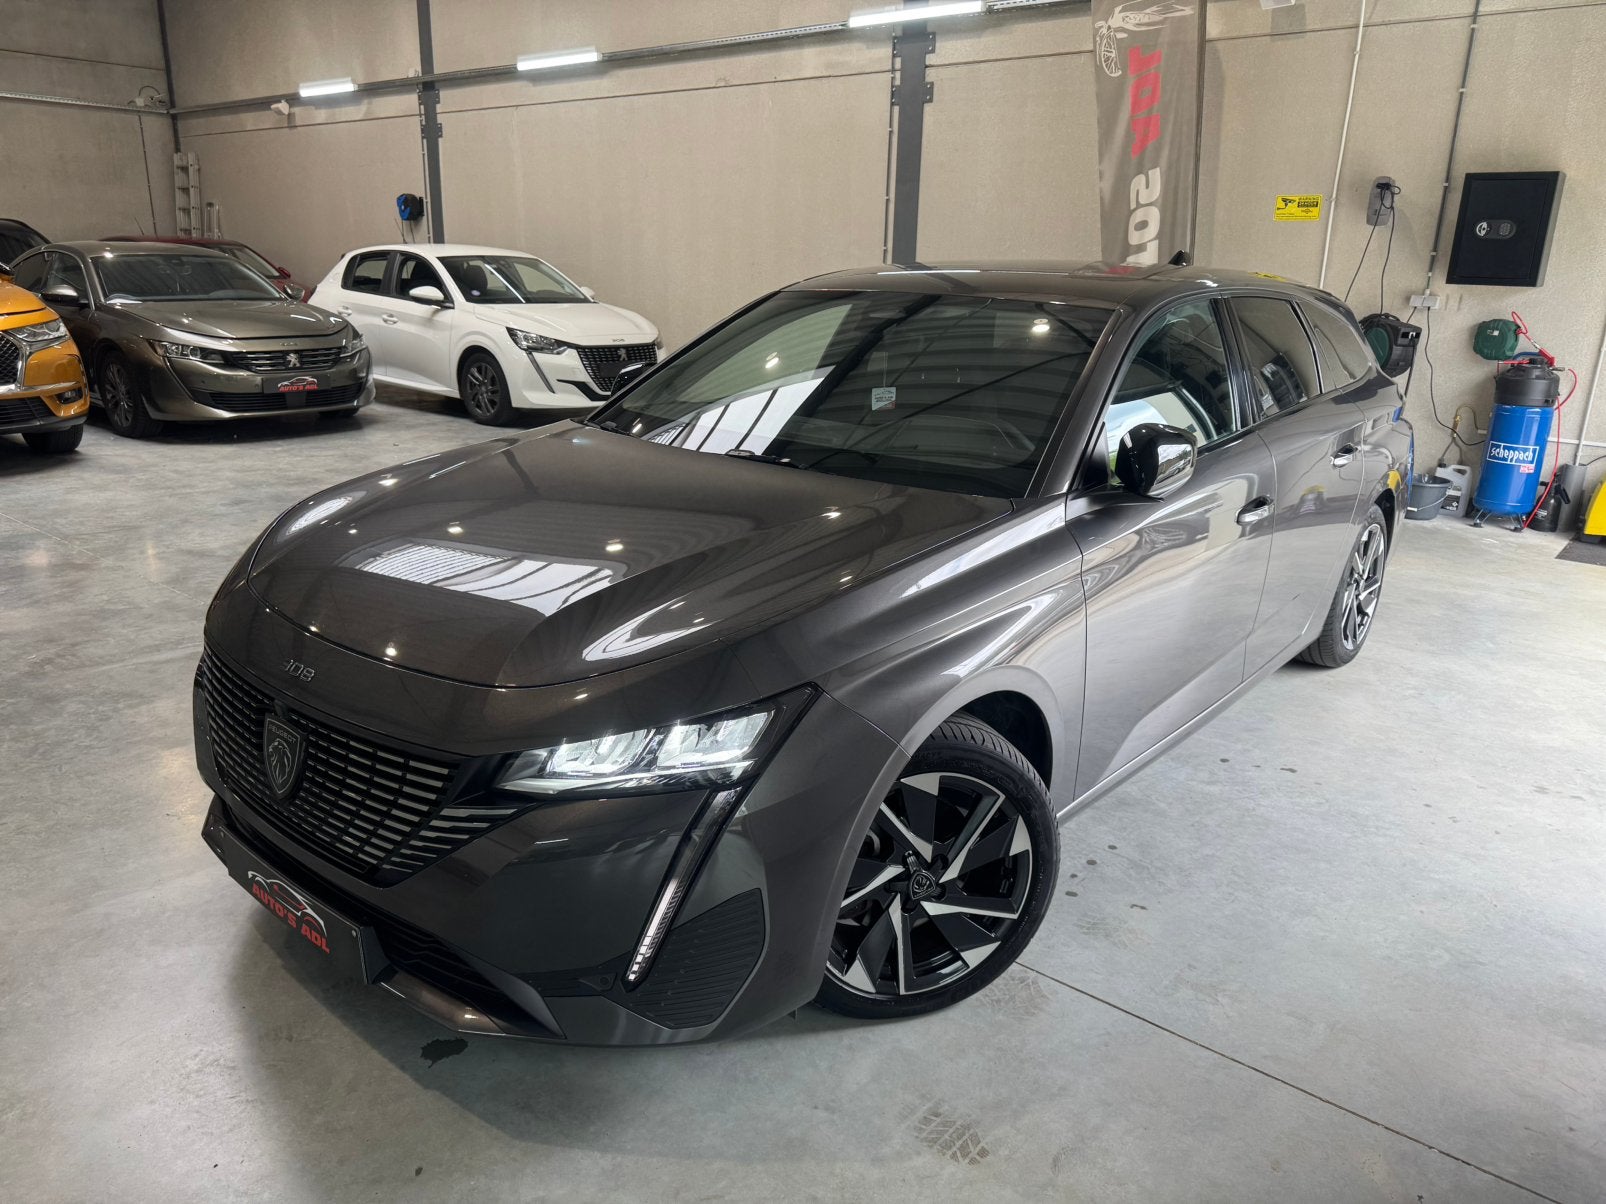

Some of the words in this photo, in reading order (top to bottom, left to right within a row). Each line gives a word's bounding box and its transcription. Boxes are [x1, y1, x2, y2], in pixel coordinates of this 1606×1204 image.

[1490, 444, 1534, 464] scheppach
[252, 882, 297, 929] AUTO'S
[301, 923, 330, 954] ADL
